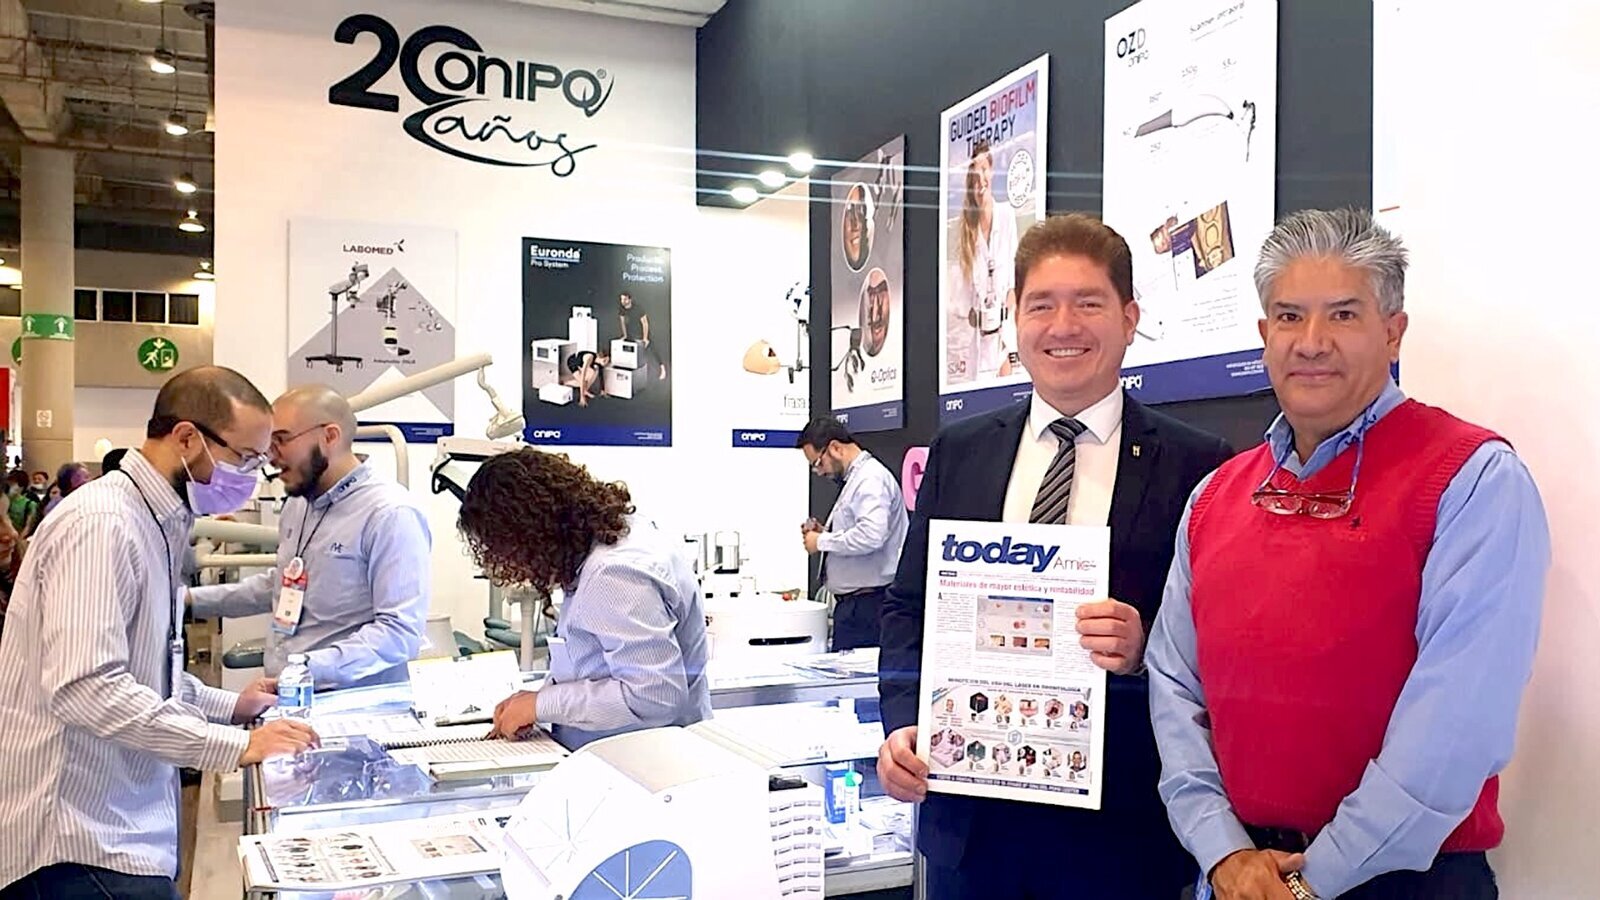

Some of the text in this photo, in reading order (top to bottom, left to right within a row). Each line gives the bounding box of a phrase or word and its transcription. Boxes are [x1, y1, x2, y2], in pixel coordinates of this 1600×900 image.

[1116, 28, 1146, 59] OZD
[950, 80, 1035, 142] GUIDED BIOFILM
[434, 115, 598, 177] años
[966, 114, 1016, 158] THERAPY
[343, 244, 394, 255] LABOMED
[941, 534, 1061, 573] today
[939, 579, 977, 589] Materiales
[979, 581, 987, 589] de
[989, 583, 1012, 592] mayor
